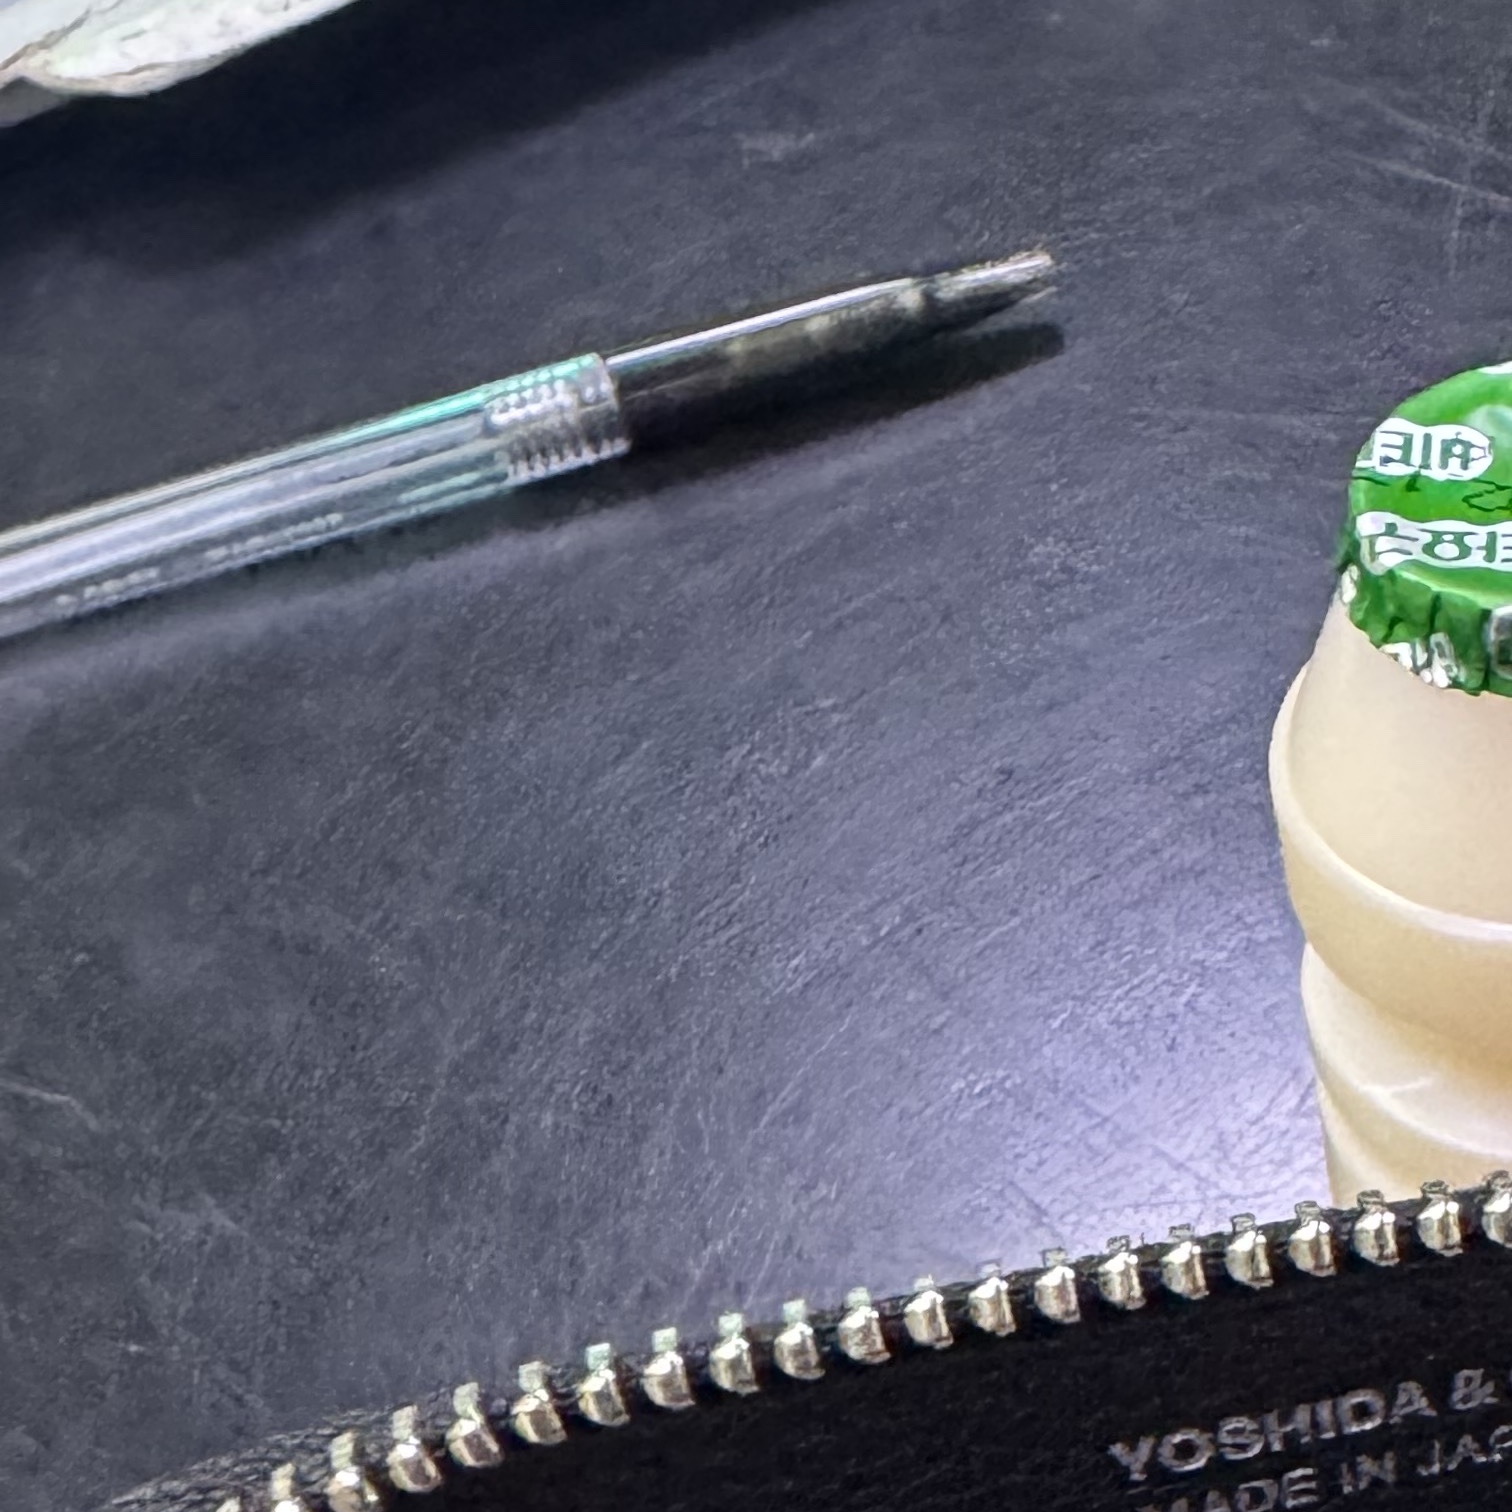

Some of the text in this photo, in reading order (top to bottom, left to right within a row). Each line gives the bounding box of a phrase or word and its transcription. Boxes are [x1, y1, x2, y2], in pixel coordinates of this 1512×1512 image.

[1108, 1381, 1437, 1482] YOSHIDA
[1448, 1367, 1499, 1411] &
[1341, 1450, 1397, 1495] IN
